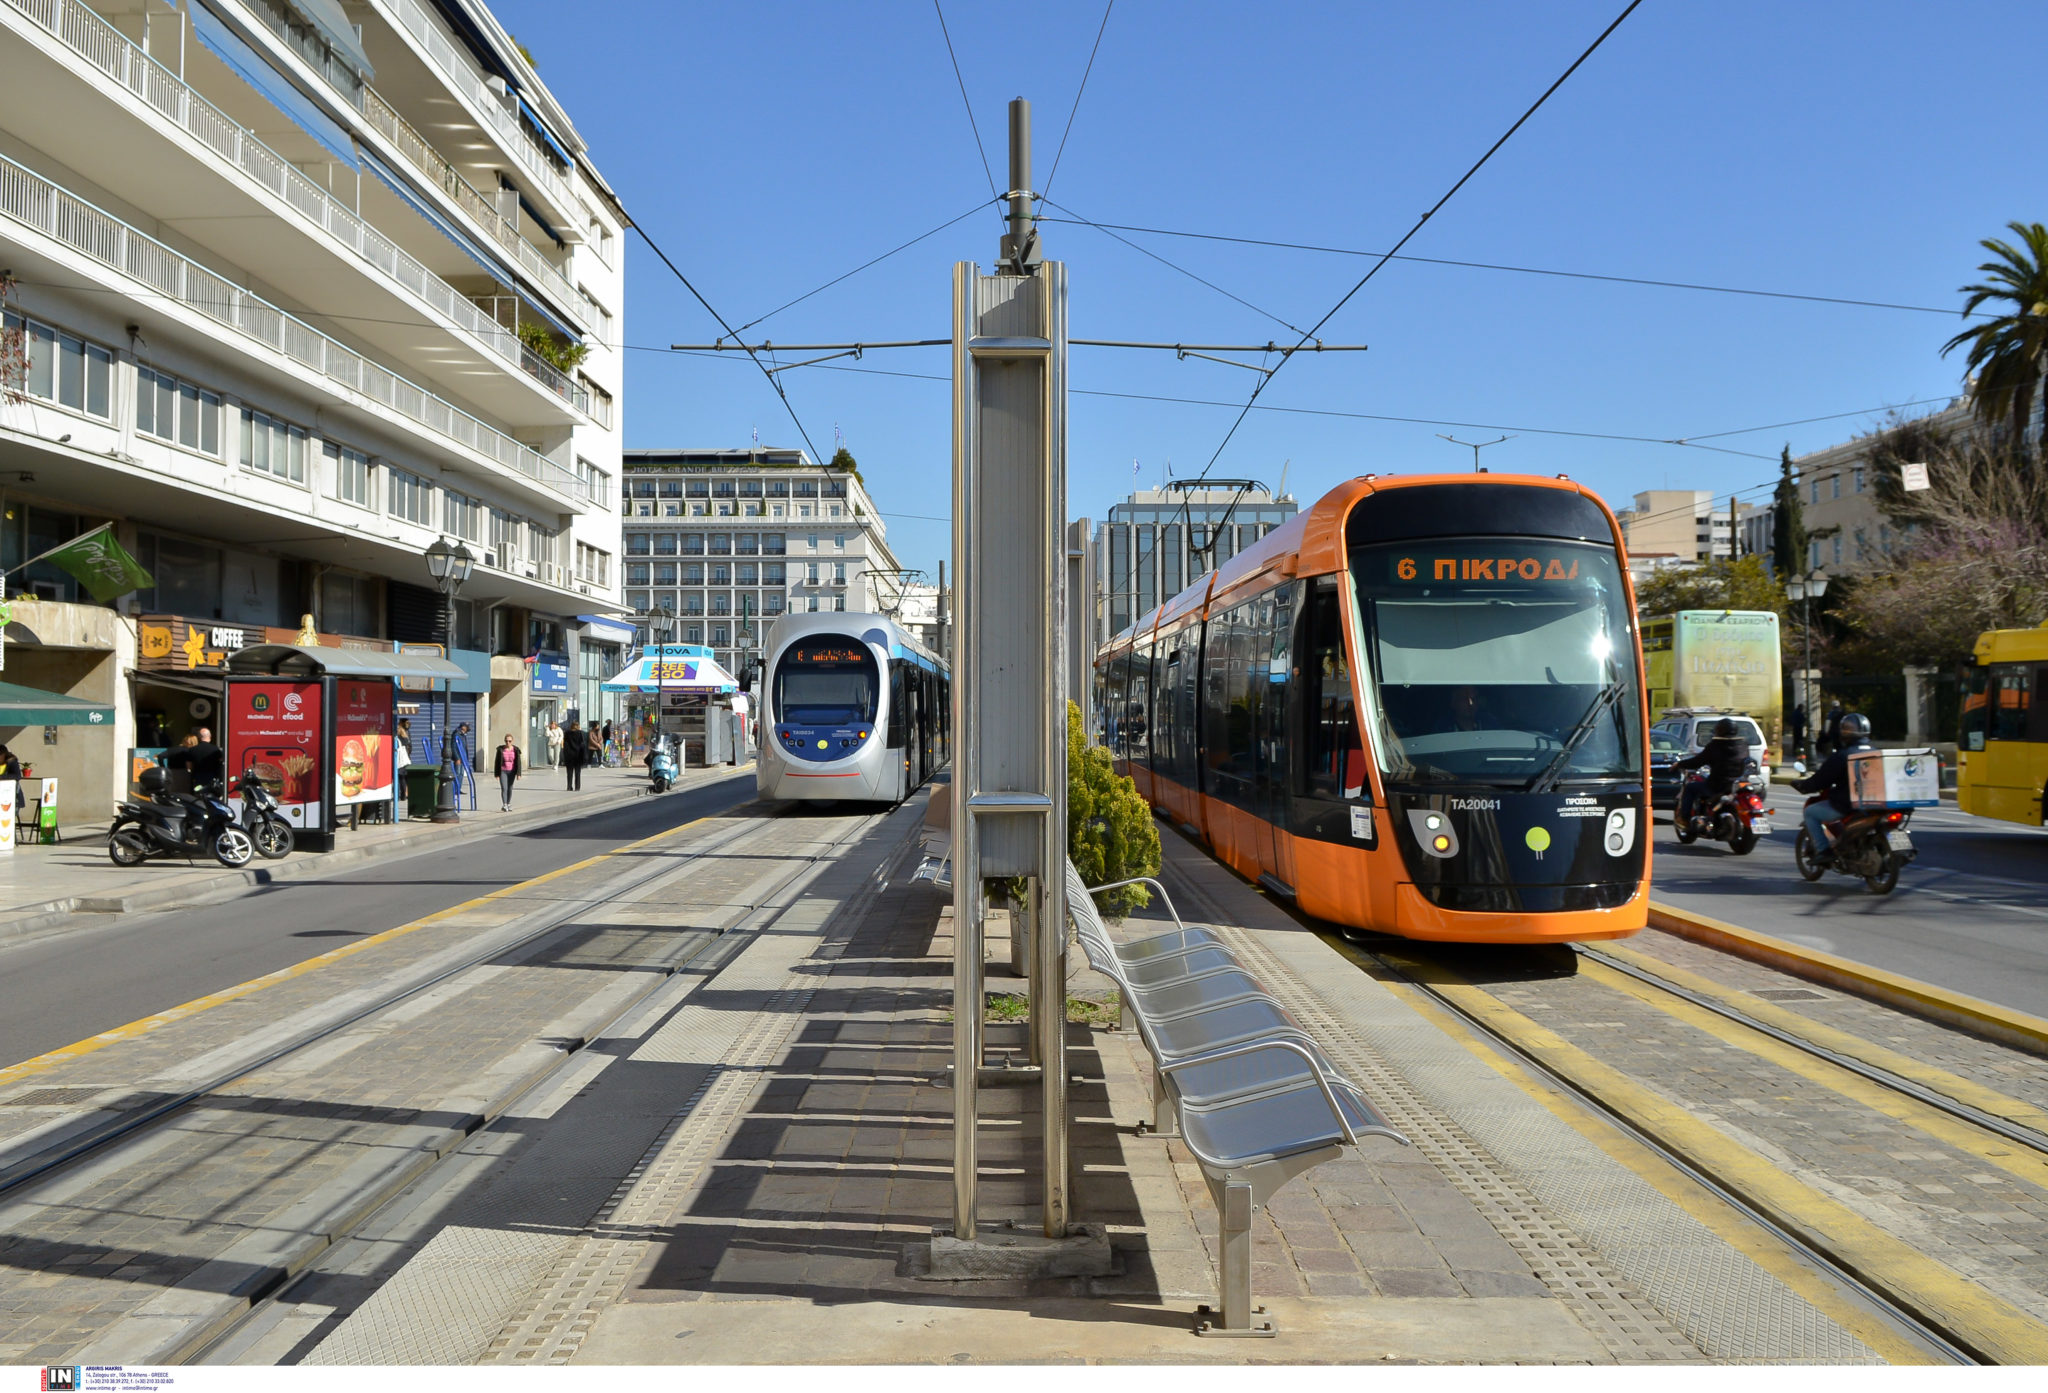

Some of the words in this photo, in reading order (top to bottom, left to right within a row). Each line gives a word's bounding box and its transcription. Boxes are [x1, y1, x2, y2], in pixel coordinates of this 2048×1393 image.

[1397, 558, 1417, 580] 6
[212, 627, 244, 648] COFFEE
[651, 662, 687, 671] FREE
[649, 670, 685, 679] 2GO
[1450, 799, 1501, 810] TA20041
